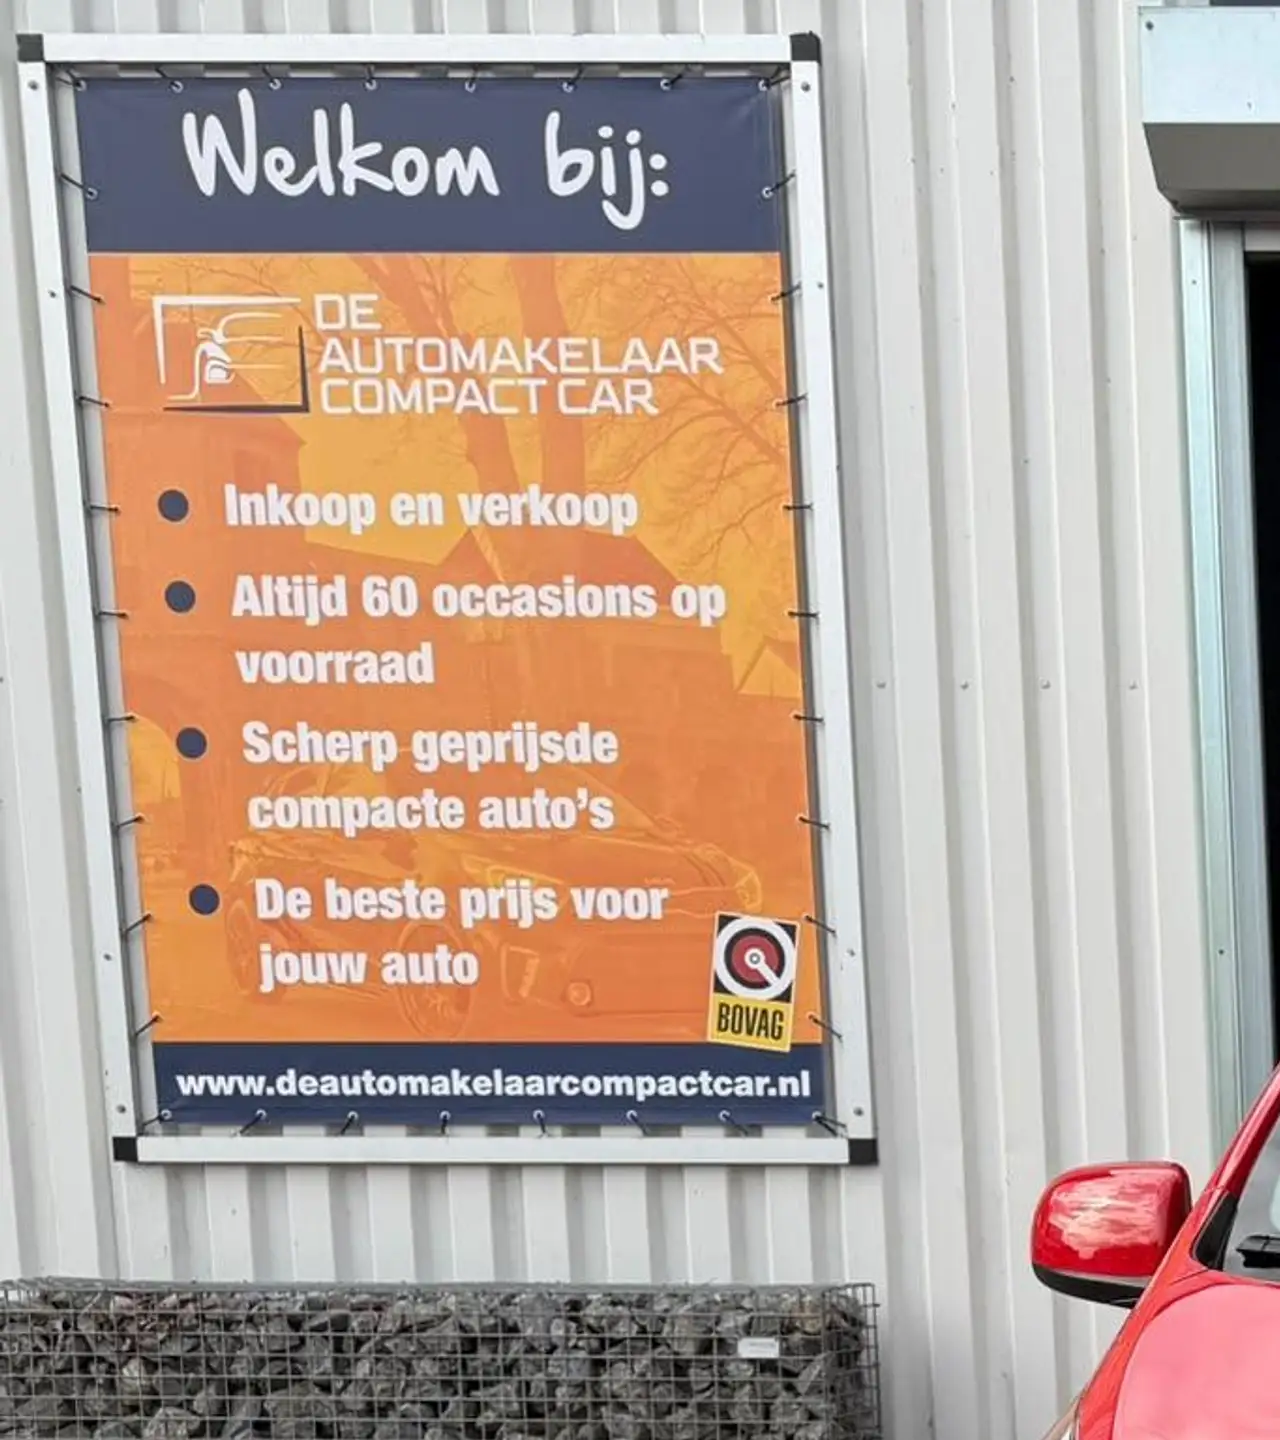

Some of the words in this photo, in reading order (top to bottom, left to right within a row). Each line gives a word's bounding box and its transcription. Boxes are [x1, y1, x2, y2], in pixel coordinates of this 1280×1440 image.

[181, 88, 499, 195] Welkom
[546, 112, 668, 229] bij:
[315, 294, 381, 330] DE
[319, 338, 723, 374] AUTOMAKELAAR
[321, 377, 547, 413] COMPACT
[558, 378, 658, 414] CAR
[224, 484, 377, 534] Inkoop
[391, 493, 444, 526] en
[459, 484, 639, 534] verkoop
[233, 576, 347, 624] Altijd
[363, 576, 418, 616] 60
[433, 576, 657, 617] occasions
[672, 585, 725, 626] op
[236, 643, 434, 683] voorraad
[243, 722, 397, 771] Scherp
[413, 722, 617, 772] geprijsde
[248, 790, 465, 835] compacte
[480, 788, 614, 828] auto's
[256, 879, 311, 919] De
[326, 879, 445, 919] beste
[460, 880, 558, 928] prijs
[571, 888, 669, 919] voor
[260, 944, 367, 992] jouw
[382, 945, 478, 984] auto
[716, 1003, 784, 1042] BOVAG
[177, 1069, 810, 1101] www.deautomakelaarcompactcar.nl
